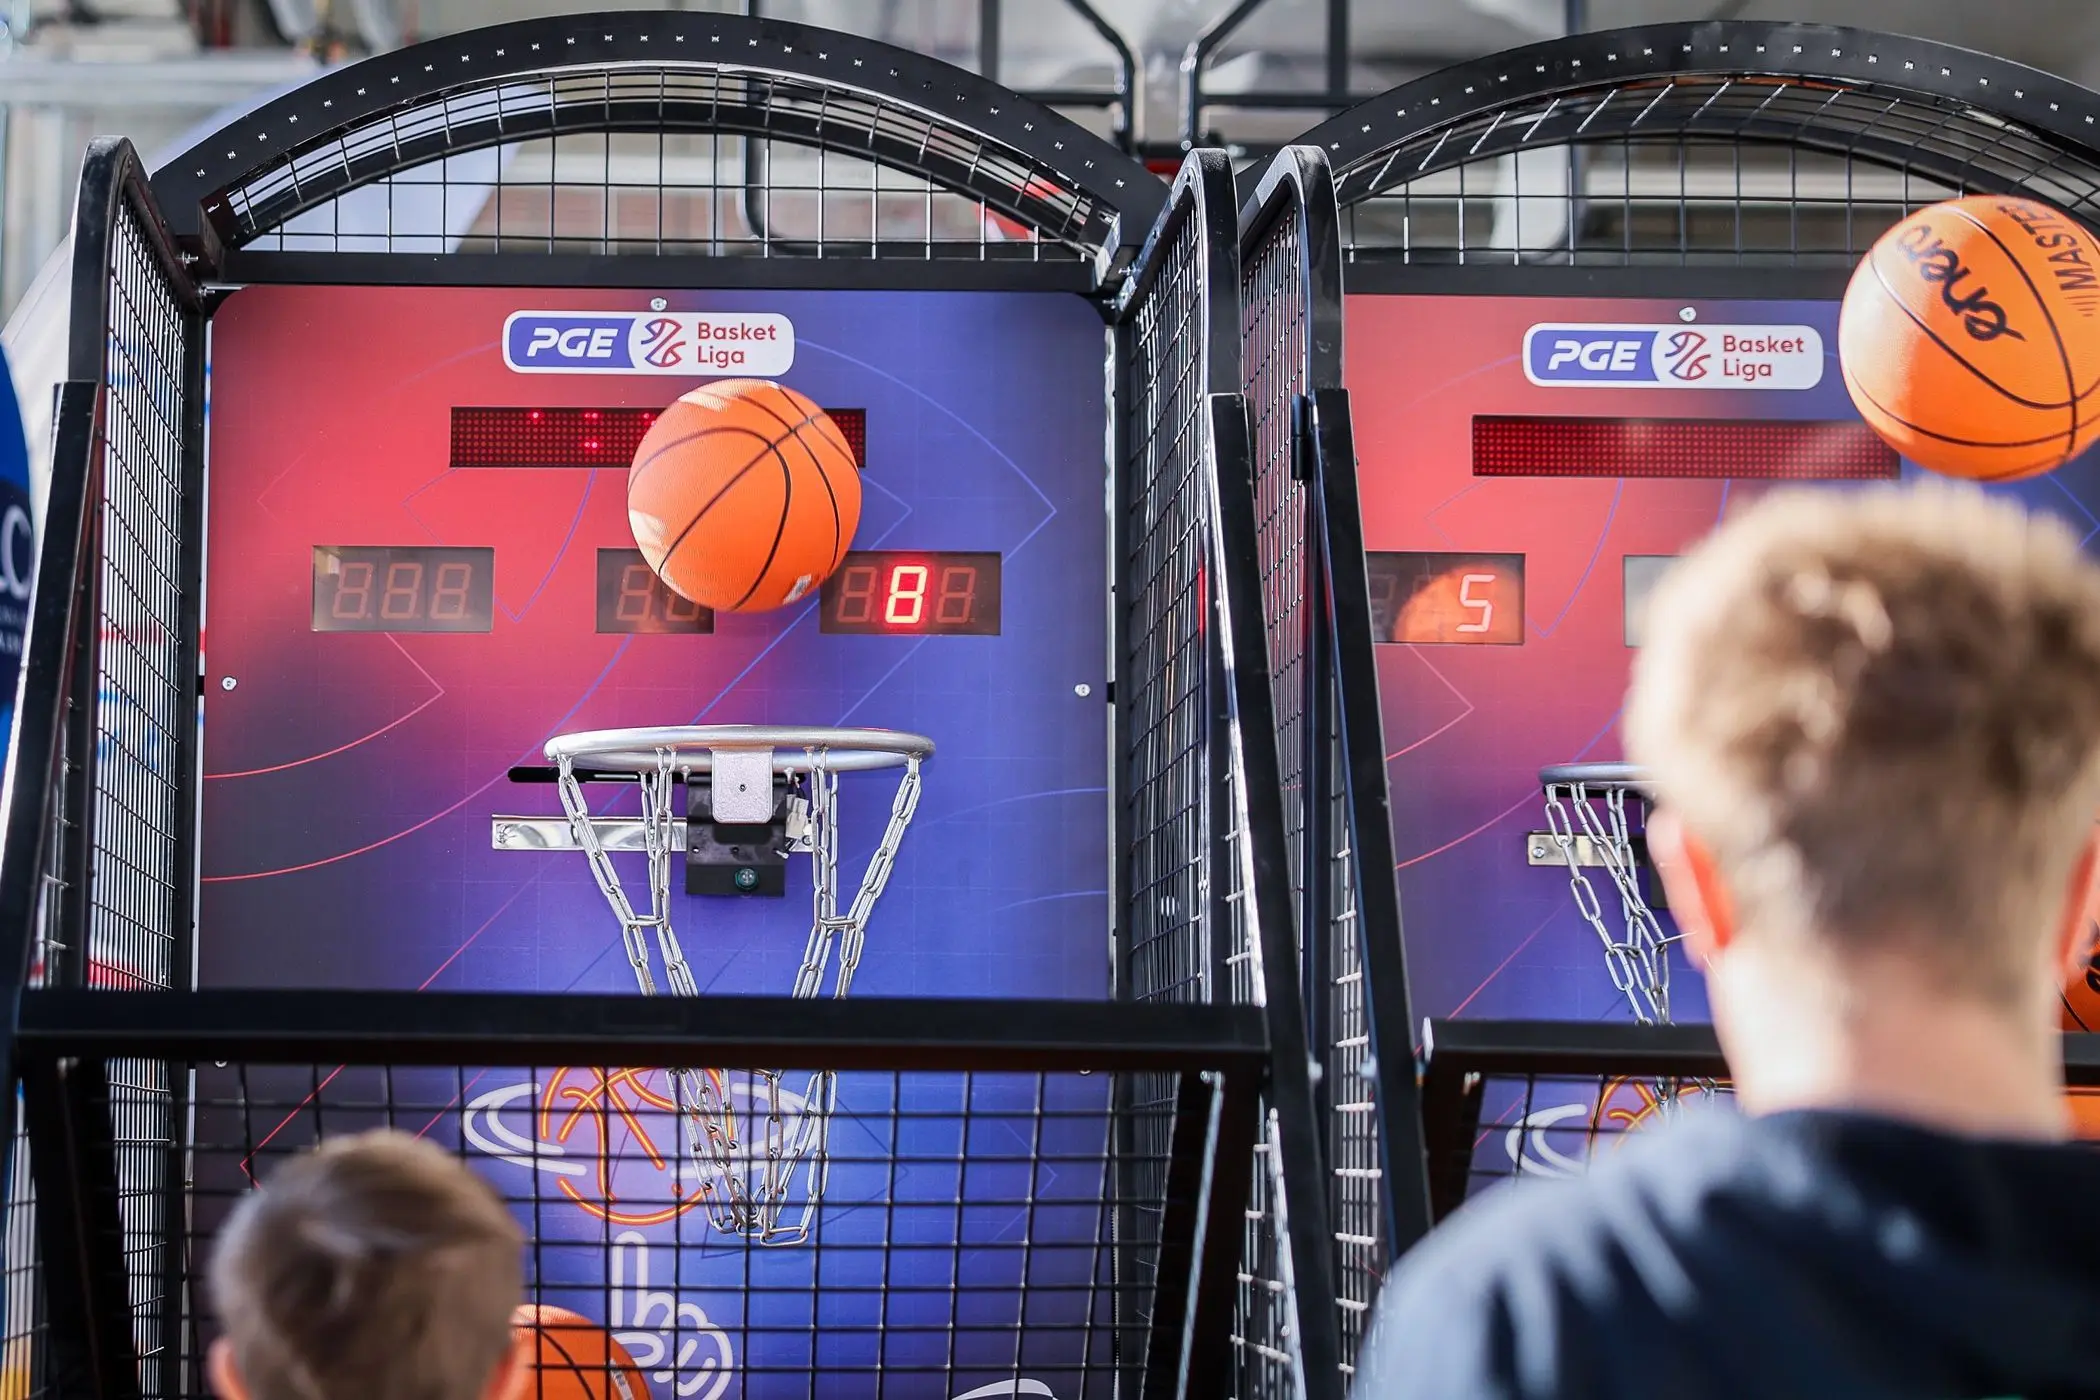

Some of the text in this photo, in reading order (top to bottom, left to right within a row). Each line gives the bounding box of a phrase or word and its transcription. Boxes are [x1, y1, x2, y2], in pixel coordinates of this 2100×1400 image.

[1898, 224, 2027, 342] enero
[526, 328, 618, 358] PGE
[697, 322, 777, 341] Basket
[697, 345, 745, 368] Liga
[1549, 342, 1642, 371] PGE
[1723, 336, 1804, 354] Basket
[1723, 360, 1772, 381] Liga
